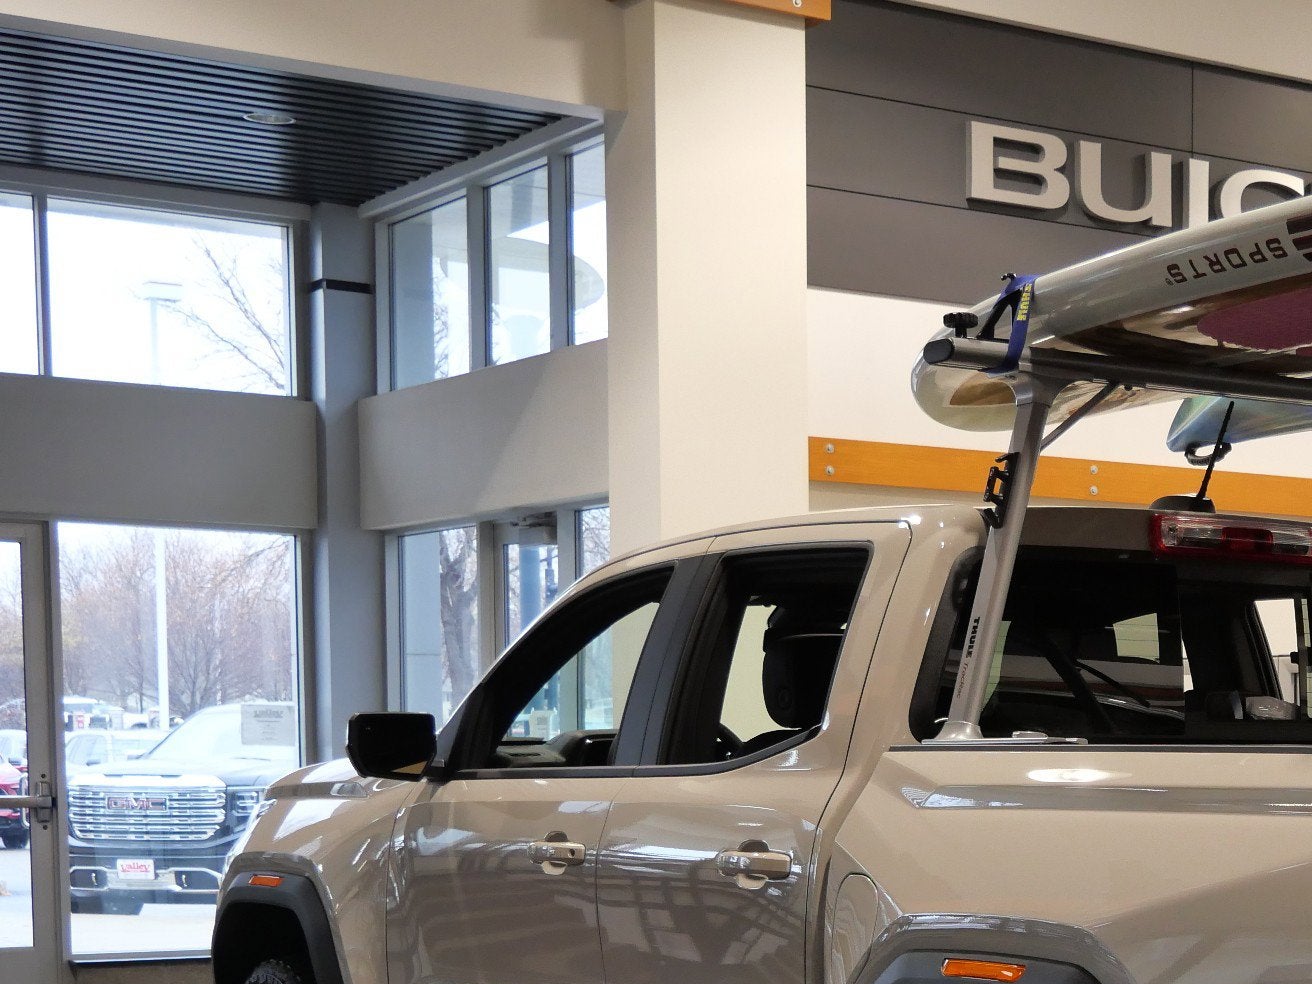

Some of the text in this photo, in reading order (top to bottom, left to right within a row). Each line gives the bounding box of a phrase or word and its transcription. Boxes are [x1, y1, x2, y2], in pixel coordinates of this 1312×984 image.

[1167, 238, 1289, 284] SPORTS
[1016, 283, 1032, 321] THULE
[966, 616, 980, 659] THULE
[109, 796, 167, 811] GMC
